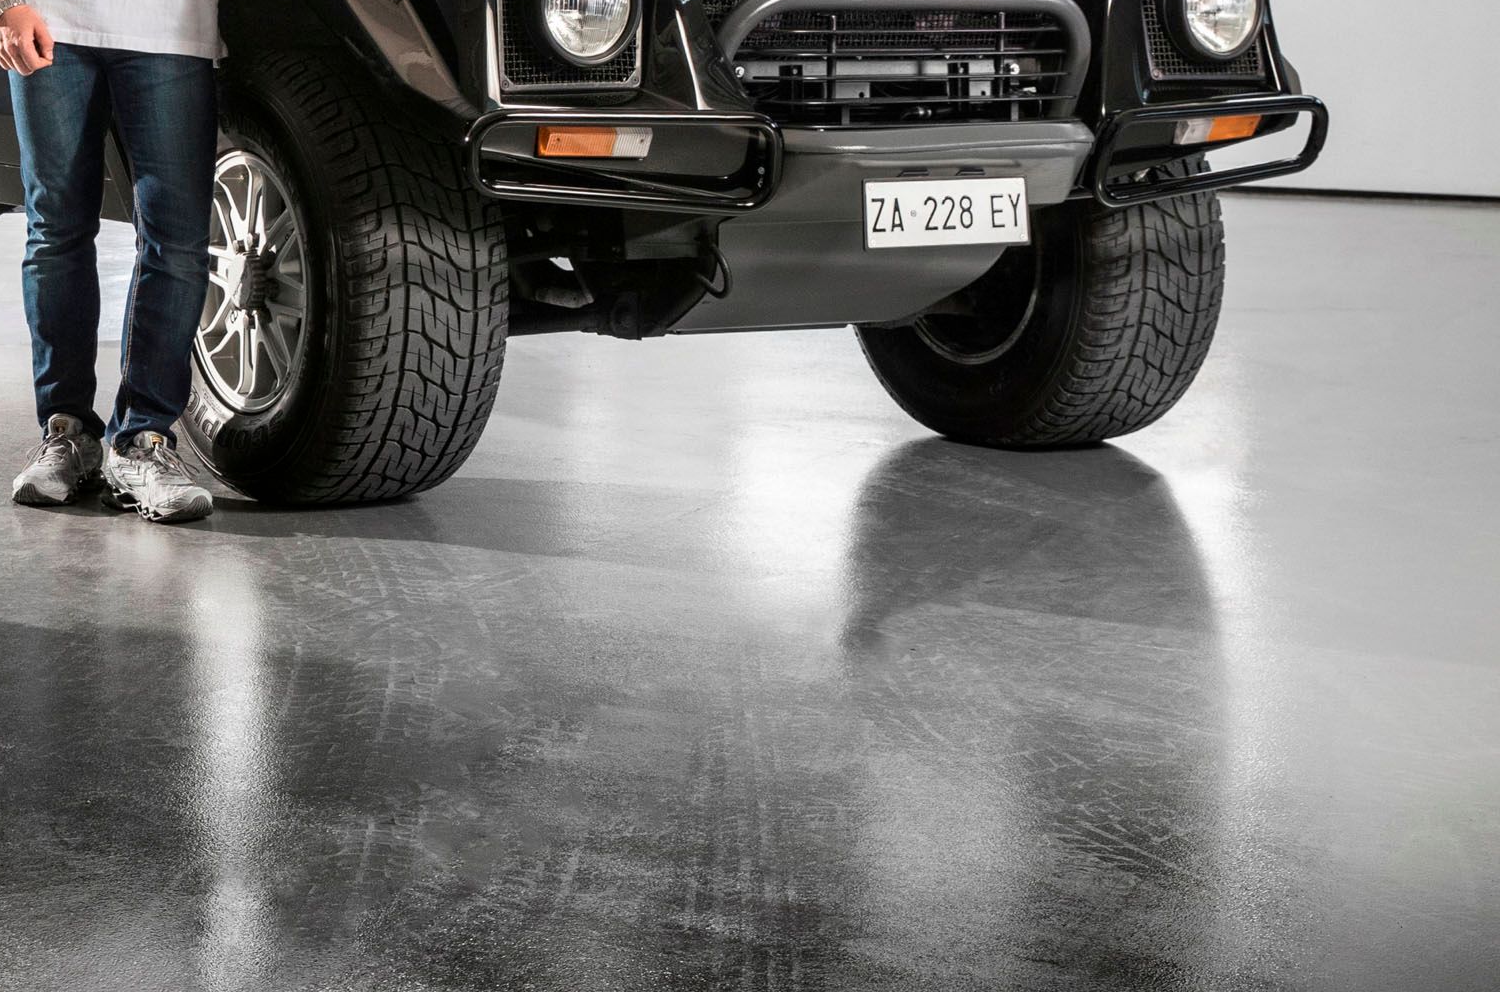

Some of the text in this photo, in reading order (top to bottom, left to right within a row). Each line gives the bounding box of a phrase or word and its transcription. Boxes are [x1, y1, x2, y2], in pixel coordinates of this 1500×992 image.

[871, 192, 1021, 233] ZA 228 EY
